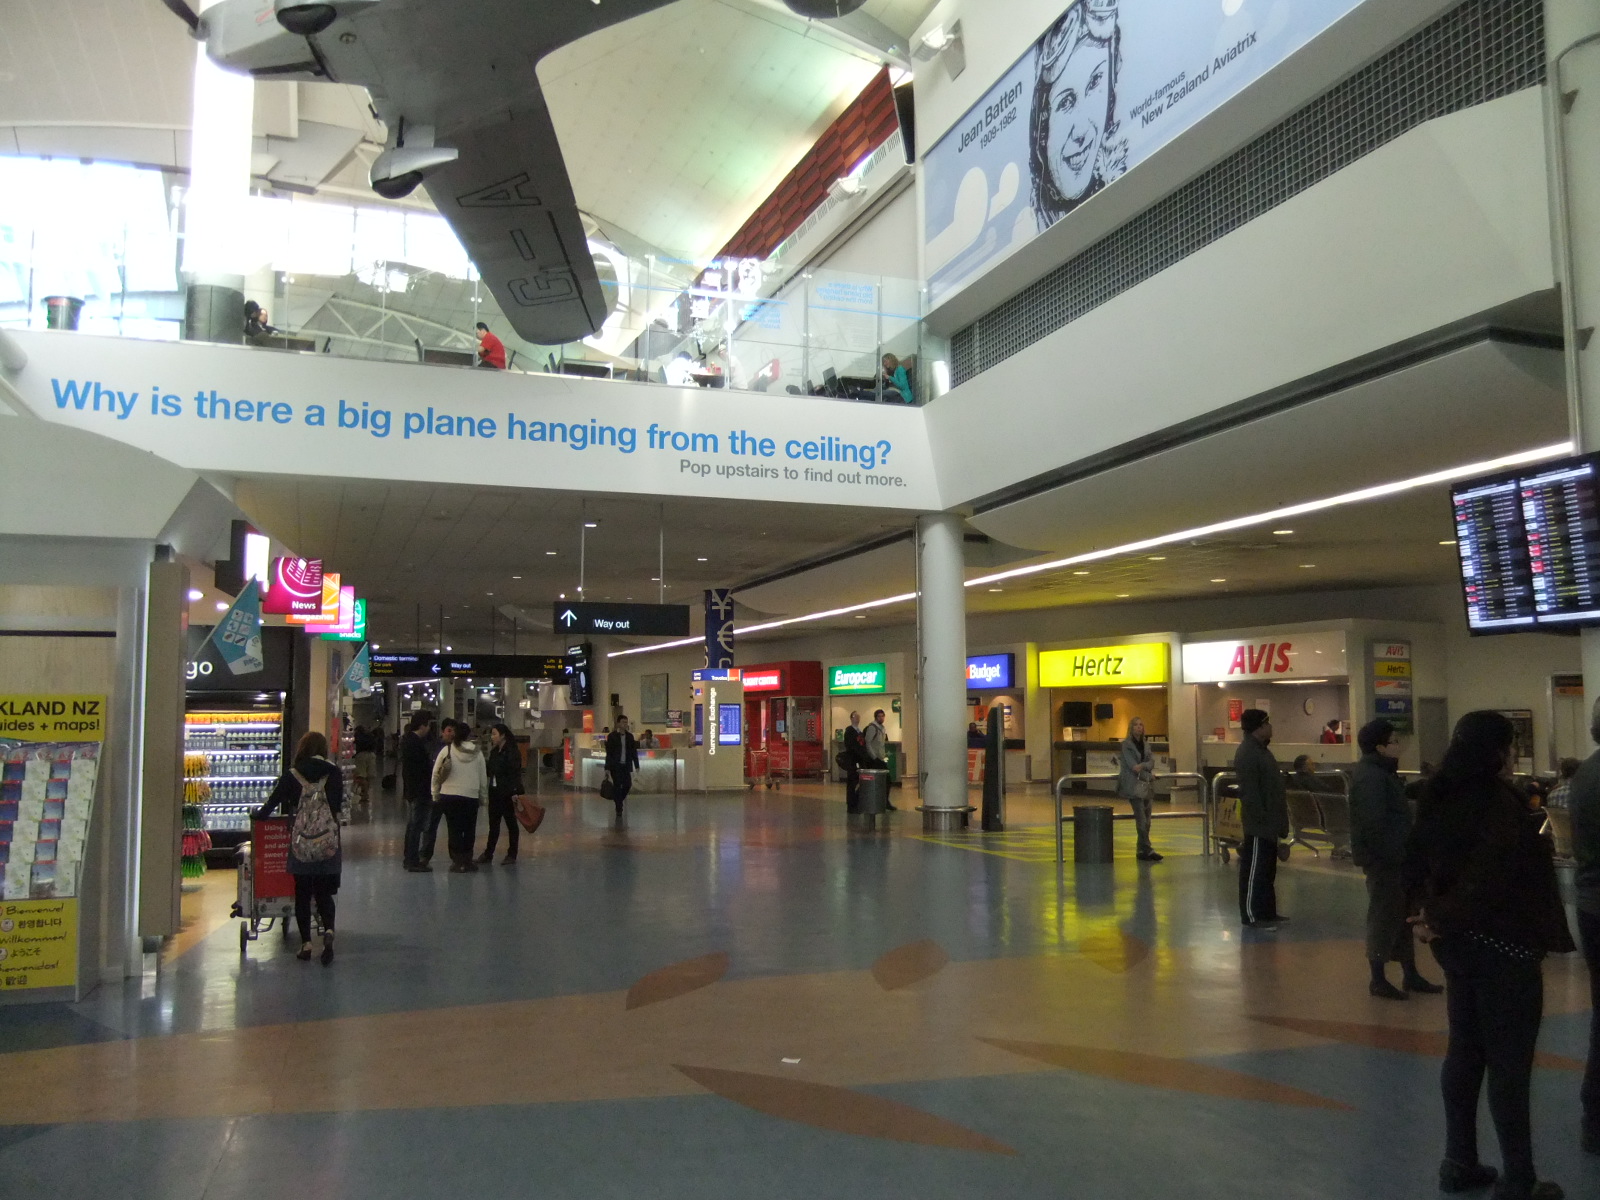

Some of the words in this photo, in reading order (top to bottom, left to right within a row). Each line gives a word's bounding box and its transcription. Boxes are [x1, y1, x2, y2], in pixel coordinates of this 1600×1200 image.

[1141, 104, 1164, 129] New
[1165, 64, 1210, 105] Zealand
[1212, 29, 1258, 75] Aviatrix
[1129, 70, 1187, 120] World-famous
[957, 119, 984, 153] Jean
[984, 81, 1024, 128] Batten
[979, 107, 1018, 150] 1909-1982
[51, 378, 139, 420] Why
[151, 386, 182, 417] is
[194, 390, 293, 424] there
[304, 404, 325, 426] a
[338, 400, 392, 438] big
[403, 406, 497, 439] plane
[507, 412, 637, 453] hanging
[647, 423, 719, 453] from
[728, 430, 776, 457] the
[785, 436, 892, 470] ceiling?
[680, 459, 711, 478] Pop
[716, 463, 779, 480] upstairs
[783, 466, 799, 480] to
[804, 468, 833, 483] find
[837, 471, 861, 485] out
[865, 474, 907, 488] more.
[291, 601, 317, 609] News
[594, 619, 613, 630] Way
[615, 620, 630, 629] out
[1228, 642, 1292, 675] AVIS
[1386, 646, 1404, 657] AVIS
[969, 663, 1001, 682] Budget
[1072, 654, 1124, 677] Hertz
[1387, 664, 1405, 674] Hertz
[834, 670, 878, 689] Europcar
[72, 701, 100, 716] NZ
[709, 687, 717, 721] Exchange
[0, 719, 35, 731] ides
[53, 719, 100, 733] maps!
[709, 722, 717, 755] Currency
